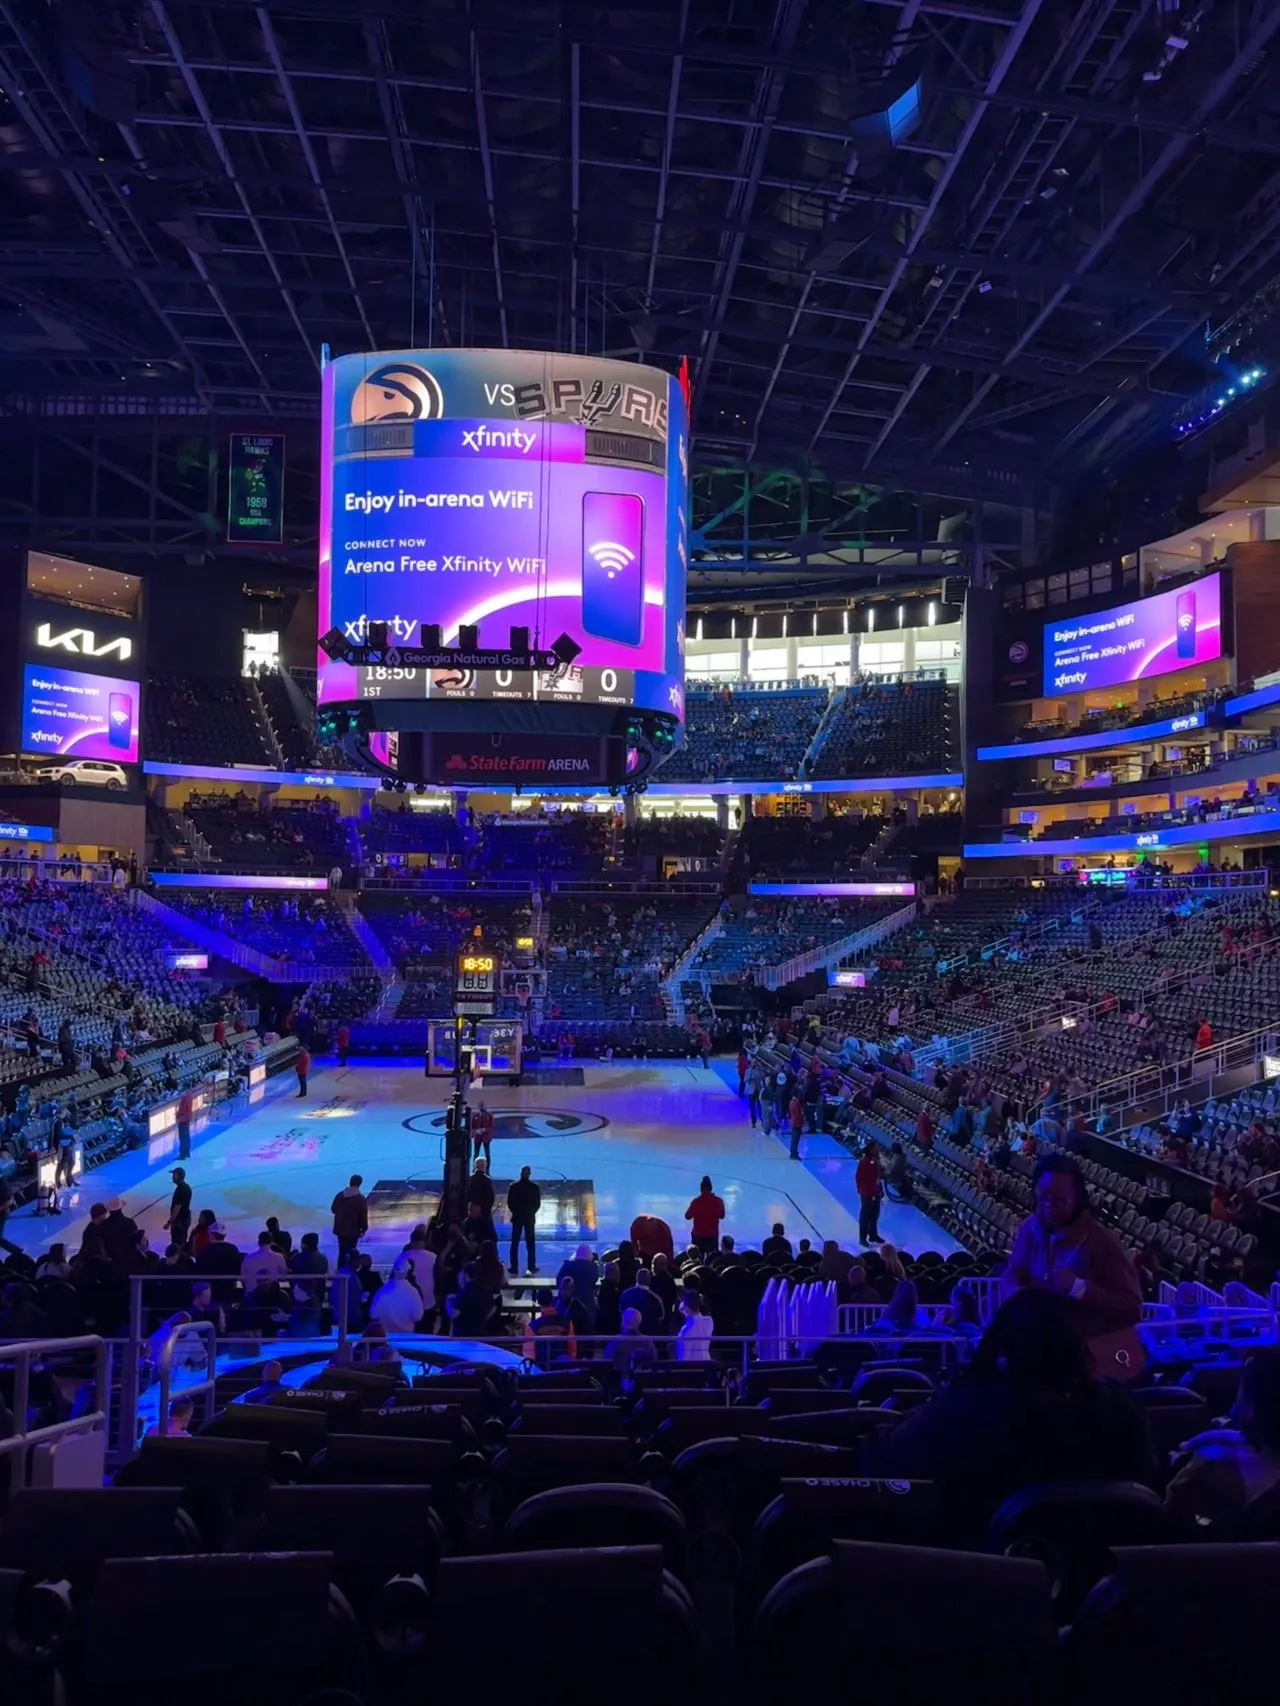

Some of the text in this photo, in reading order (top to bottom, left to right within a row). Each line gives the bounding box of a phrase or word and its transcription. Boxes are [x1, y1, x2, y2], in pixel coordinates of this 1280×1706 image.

[484, 383, 515, 406] VS
[461, 425, 537, 454] xfinity
[246, 496, 267, 509] 1958
[345, 489, 533, 514] Enjoy in-arena WiFi
[344, 538, 426, 550] CONNECT NOW
[344, 555, 546, 577] Arena Free Xfinity WiFi
[1054, 613, 1135, 642] Enjoy in-arena WiFi
[403, 652, 525, 665] Georgia Natural Gas
[1054, 638, 1145, 667] Arena Free Xfinity WiFi
[32, 679, 53, 691] Enjoy
[366, 666, 416, 680] 18:50
[601, 669, 618, 692] 0
[1054, 672, 1087, 687] xfinity
[363, 687, 382, 697] 1ST
[31, 707, 52, 716] Arena
[52, 709, 67, 718] Free
[31, 730, 64, 744] xfinity
[547, 758, 590, 771] ARENA
[464, 957, 493, 971] 18:50
